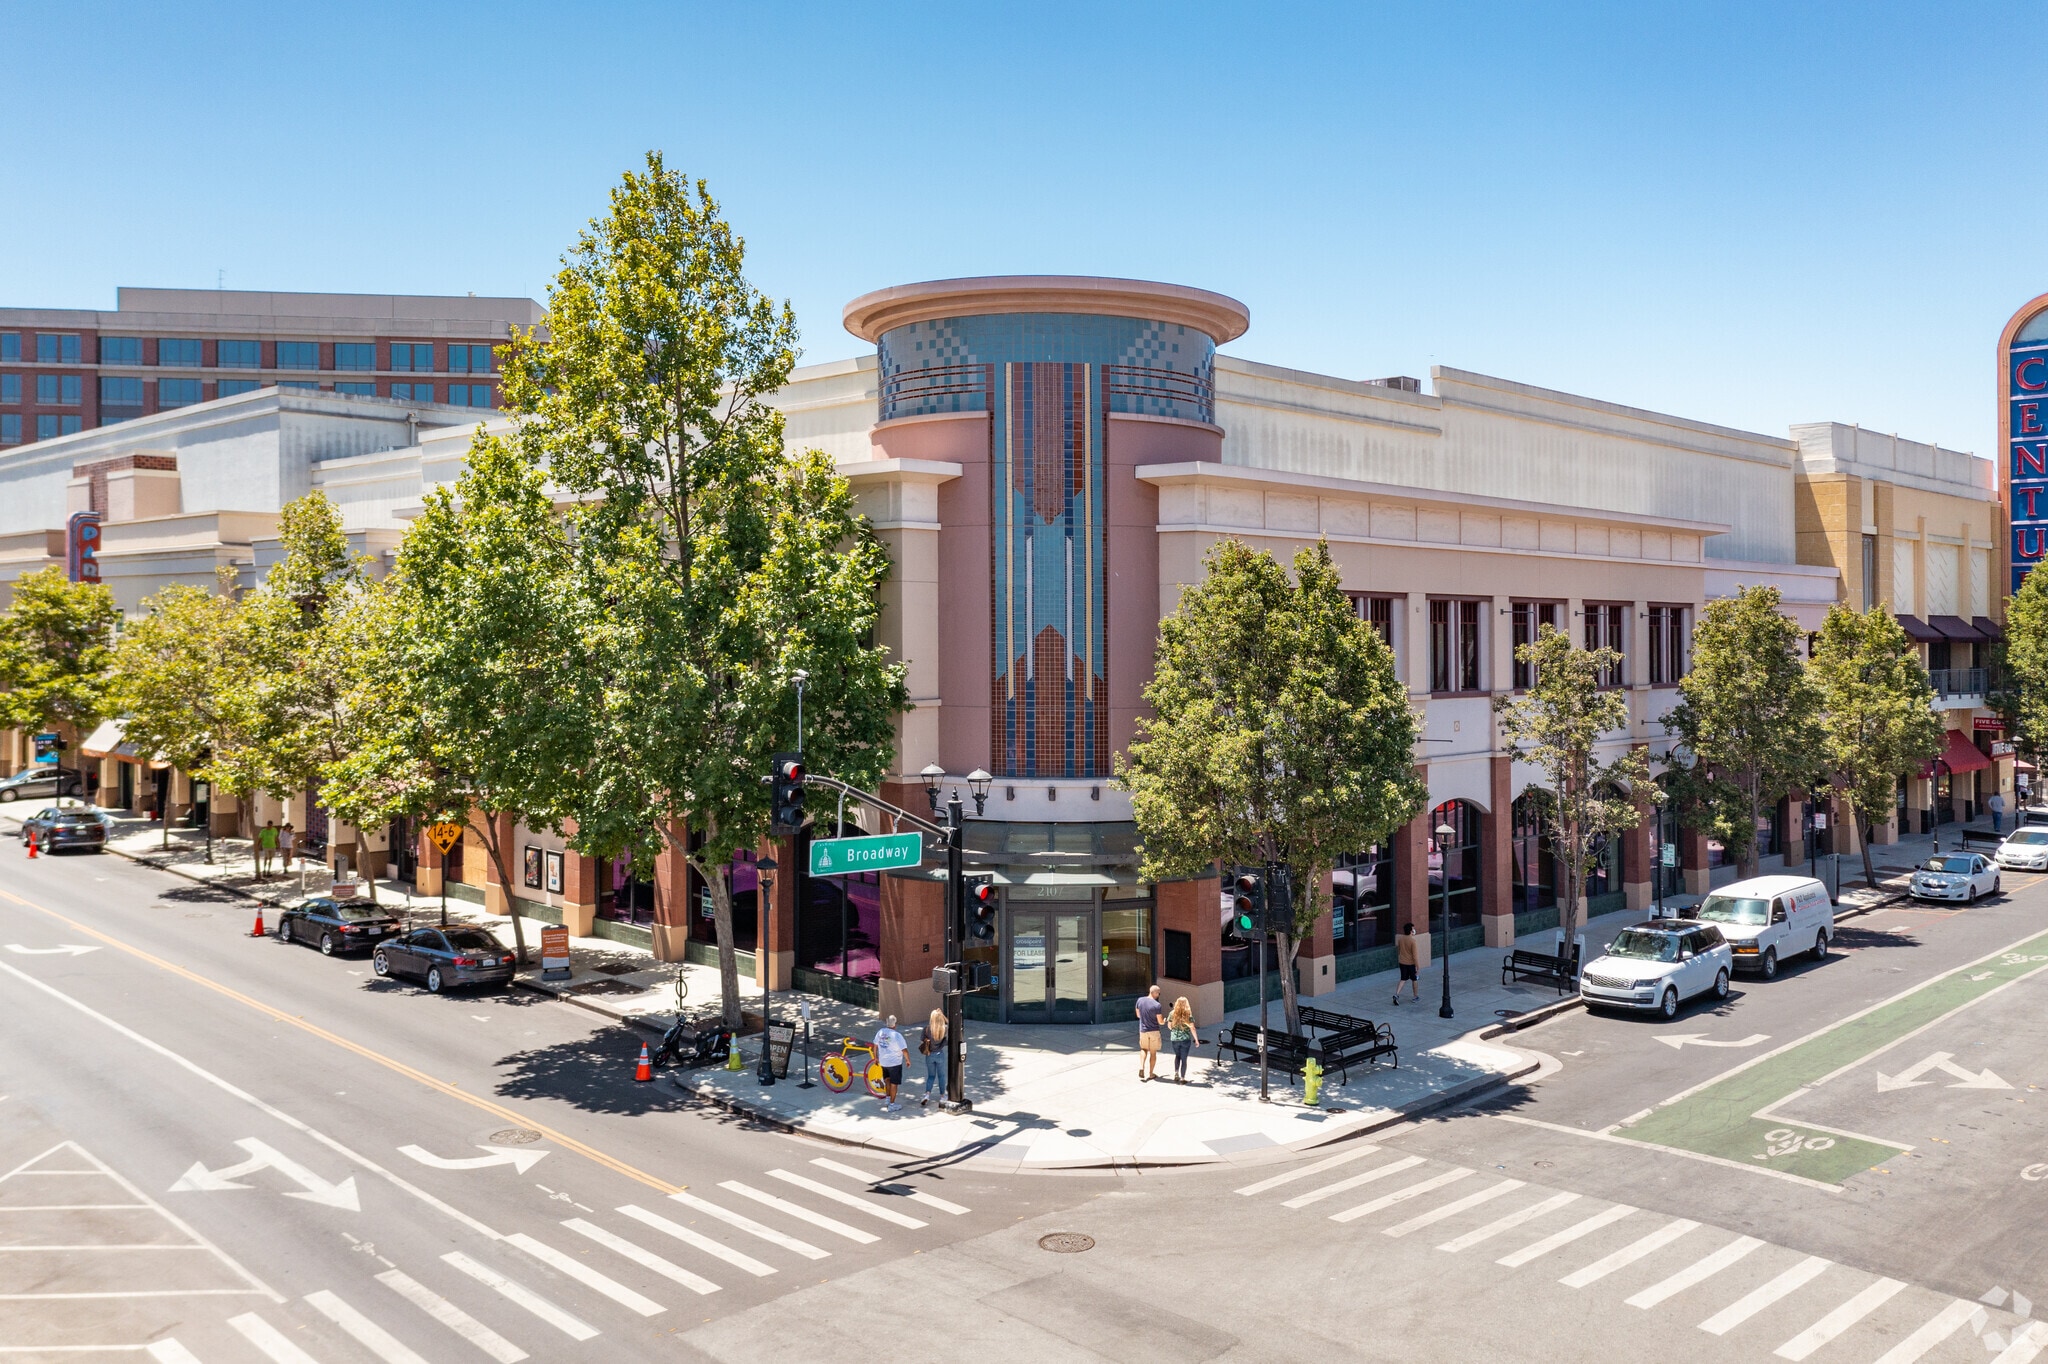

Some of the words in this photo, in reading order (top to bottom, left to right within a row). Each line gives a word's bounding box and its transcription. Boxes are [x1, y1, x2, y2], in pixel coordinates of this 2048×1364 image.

[2015, 357, 2047, 583] CENTU
[82, 526, 98, 585] PAR
[847, 846, 909, 862] Broadway
[1037, 886, 1064, 897] 2107
